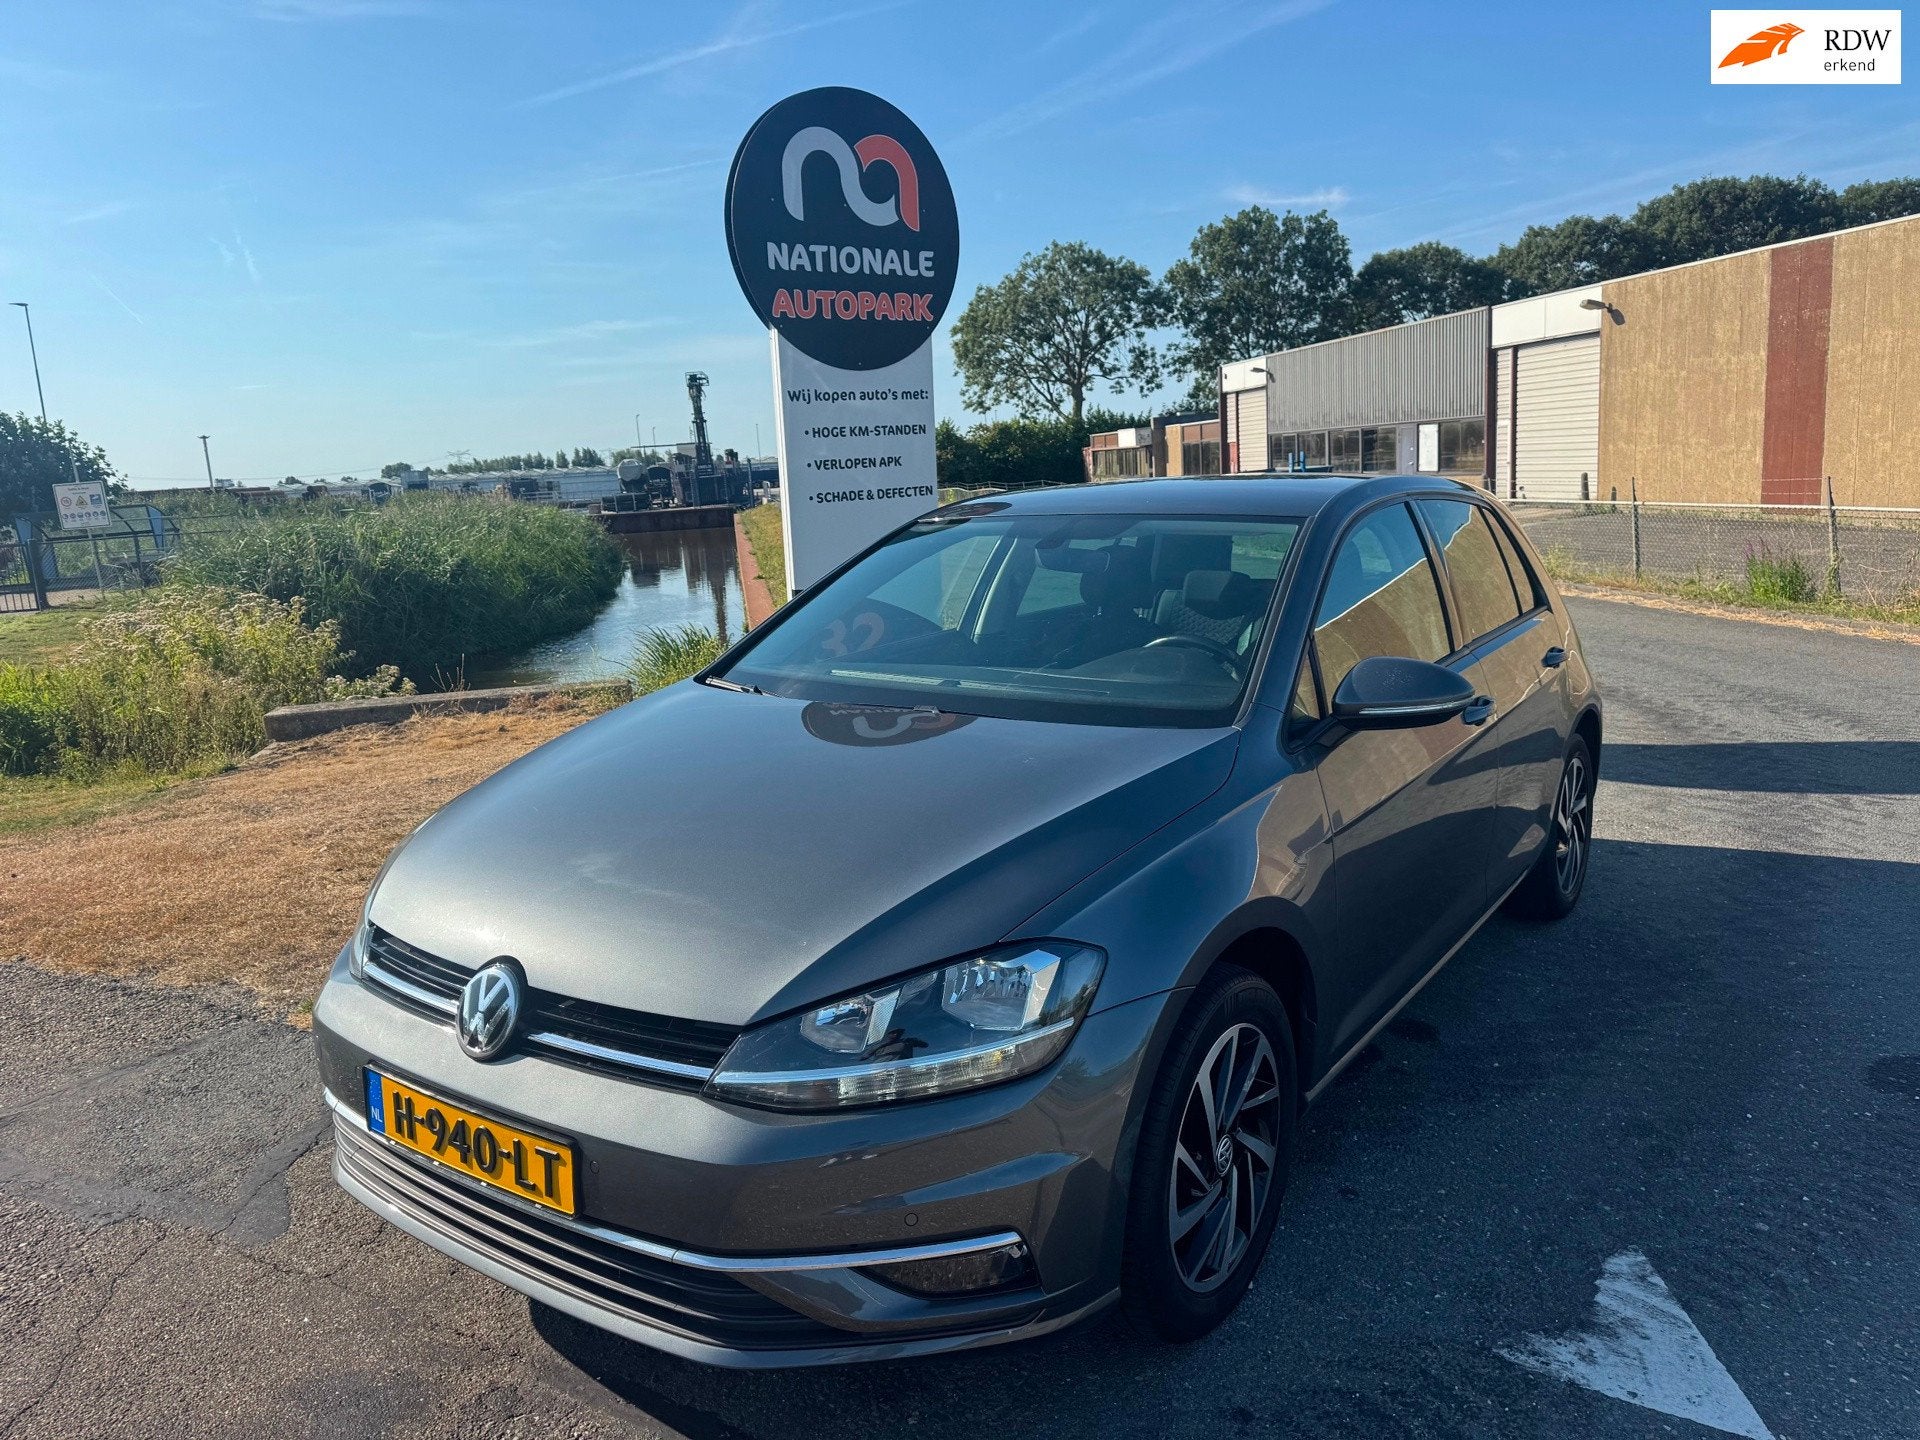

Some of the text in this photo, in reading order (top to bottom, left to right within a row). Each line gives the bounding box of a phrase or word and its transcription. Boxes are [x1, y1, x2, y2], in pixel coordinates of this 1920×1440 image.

[767, 242, 935, 277] NATIONALE
[772, 288, 934, 321] AUTOPARK
[788, 388, 929, 404] Wij kopen auto's met:
[812, 424, 927, 438] HOGE KM-STANDEN
[814, 456, 902, 470] VERLOPEN APK
[816, 485, 933, 503] SCHADE & DEFECTEN
[371, 1105, 383, 1123] NL
[392, 1090, 561, 1199] H-940-LT
